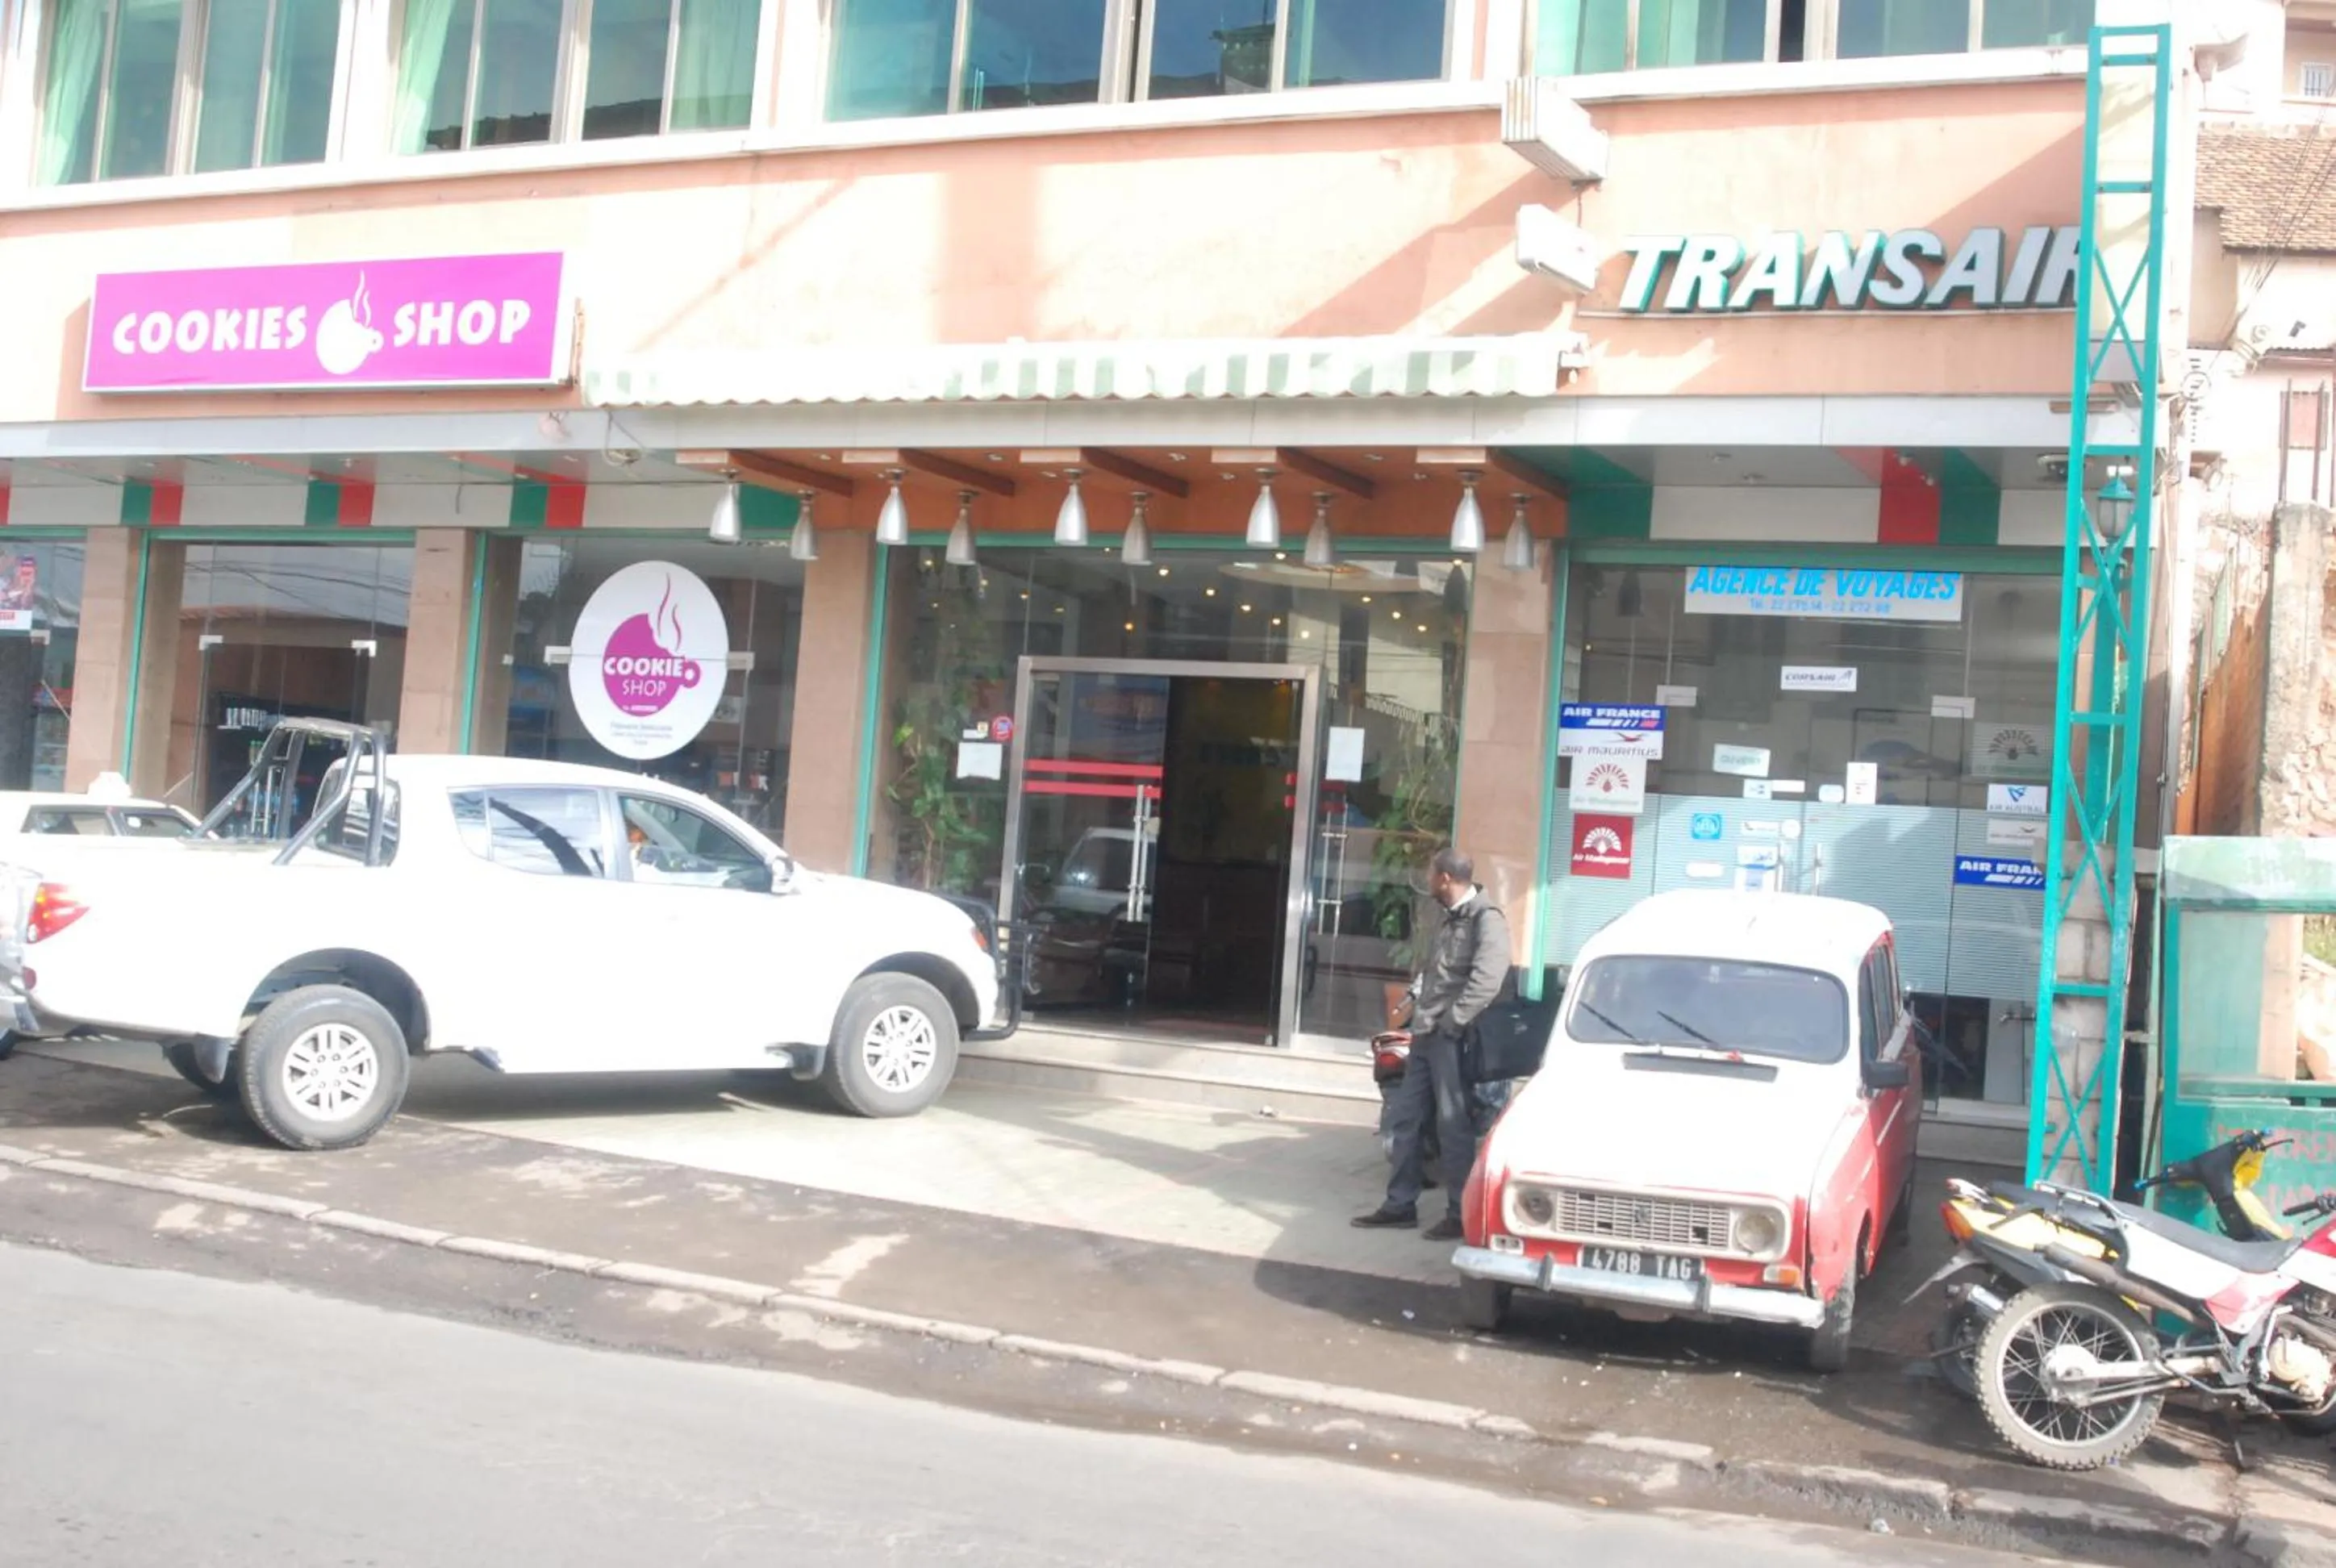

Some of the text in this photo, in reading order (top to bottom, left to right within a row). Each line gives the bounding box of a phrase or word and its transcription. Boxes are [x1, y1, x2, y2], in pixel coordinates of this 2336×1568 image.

[112, 299, 531, 355] COOKIES SHOP
[1690, 565, 1959, 600] AGENCE DE VOYAGES
[603, 657, 684, 678] COOKIE
[622, 678, 667, 697] SHOP
[1563, 707, 1662, 719] AIR FRANCE
[1958, 860, 1992, 872] AIR
[1591, 1248, 1692, 1281] 4788 TAG
